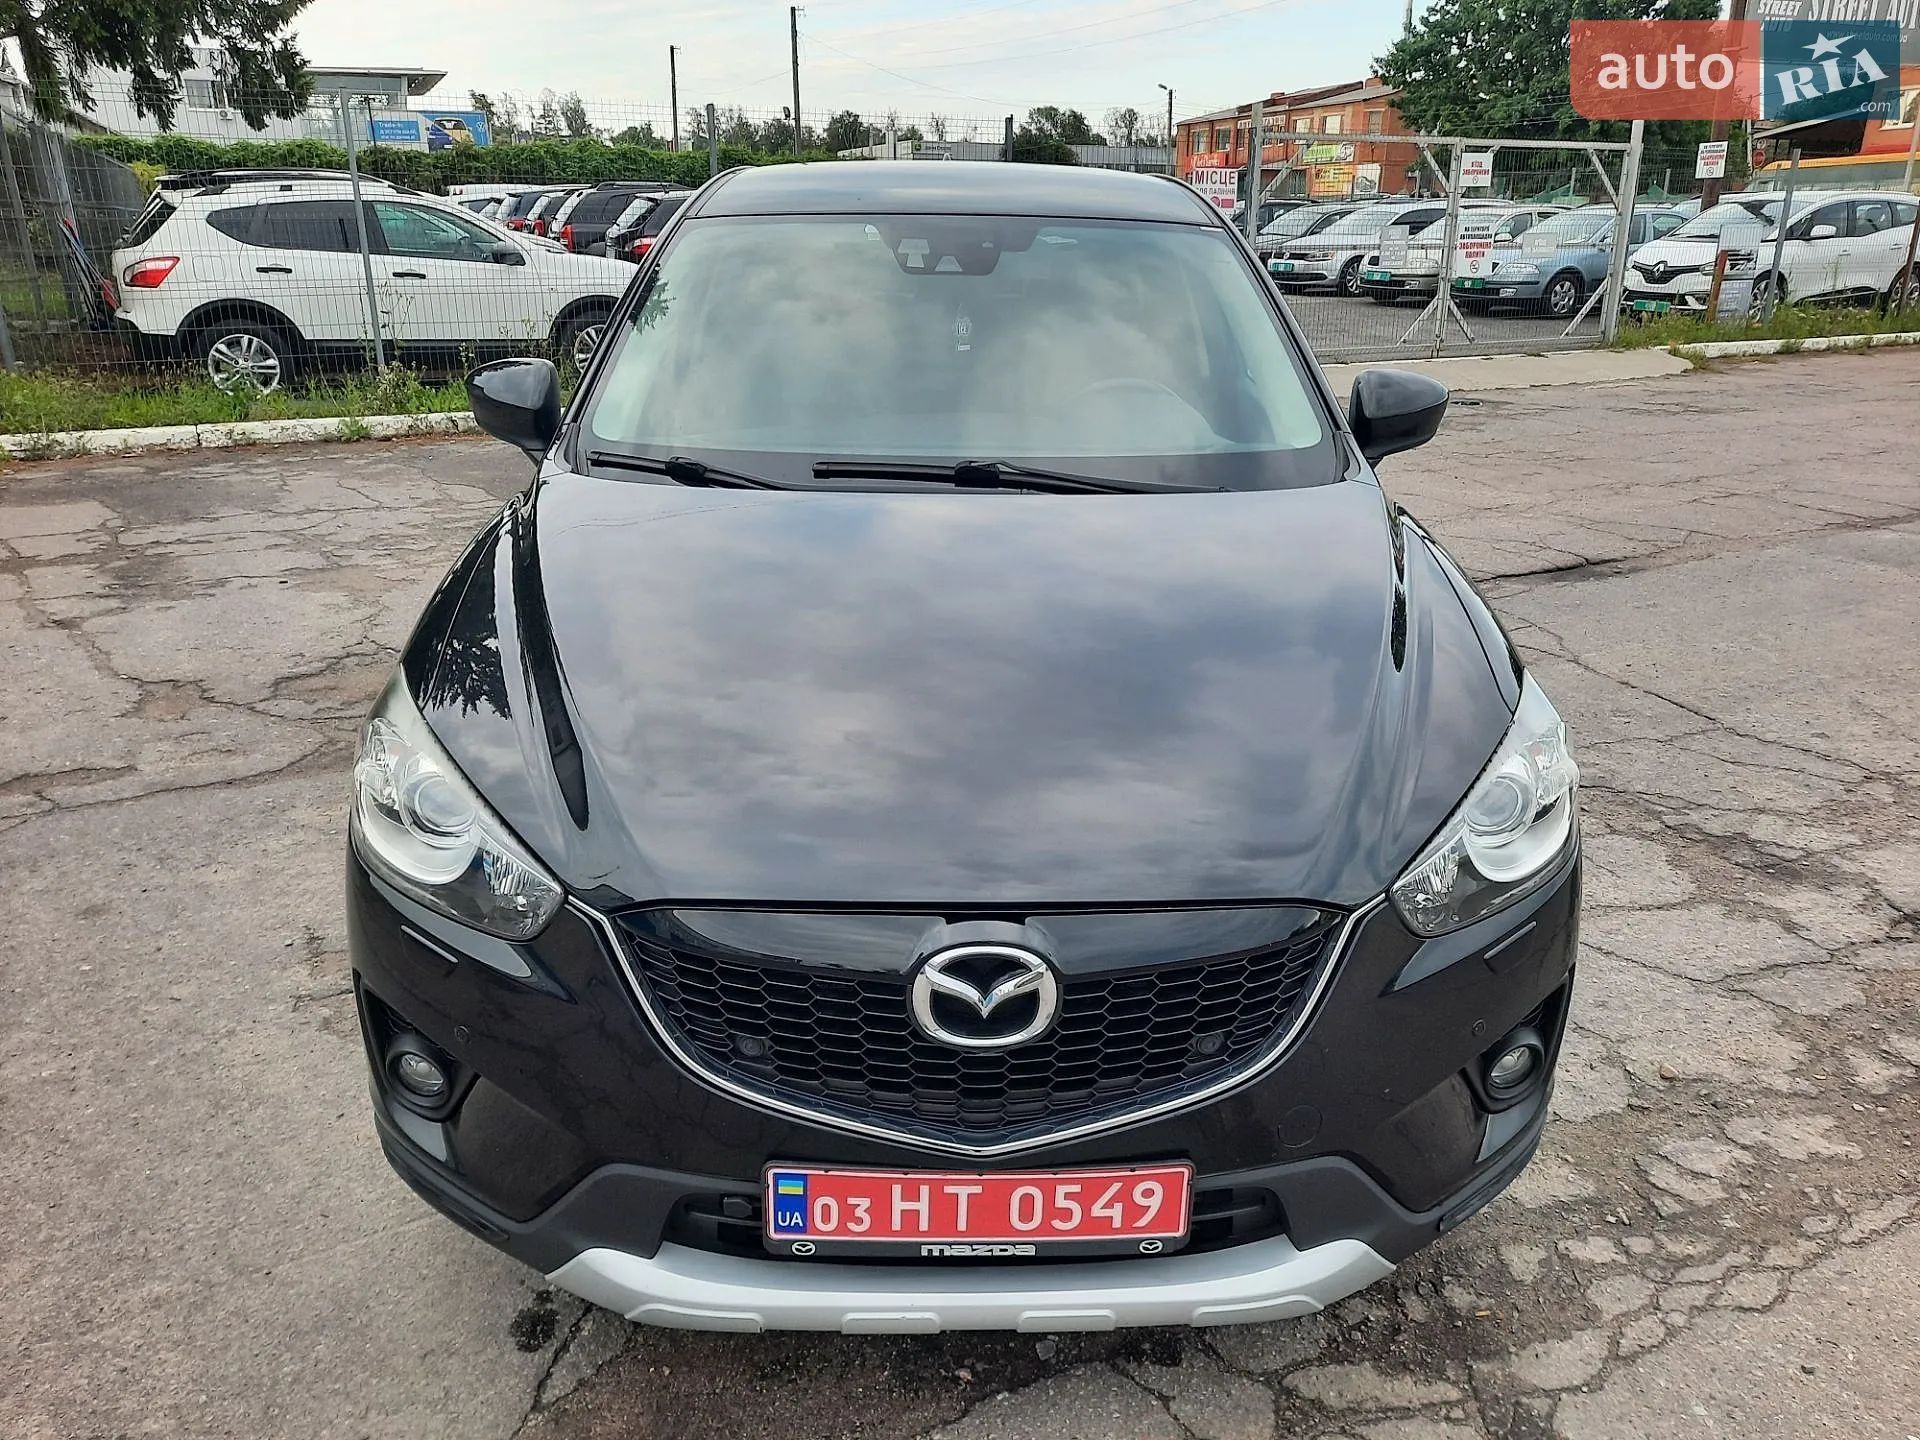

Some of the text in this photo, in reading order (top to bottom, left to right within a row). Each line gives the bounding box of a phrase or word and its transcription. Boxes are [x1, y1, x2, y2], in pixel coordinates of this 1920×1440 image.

[1757, 0, 1802, 16] STREET
[1883, 0, 1920, 29] AUT
[1760, 16, 1794, 32] AUTO
[1195, 170, 1236, 187] МІСЦЕ
[1196, 187, 1208, 195] ЛЯ
[777, 1180, 1164, 1233] UA 03 HT 0549
